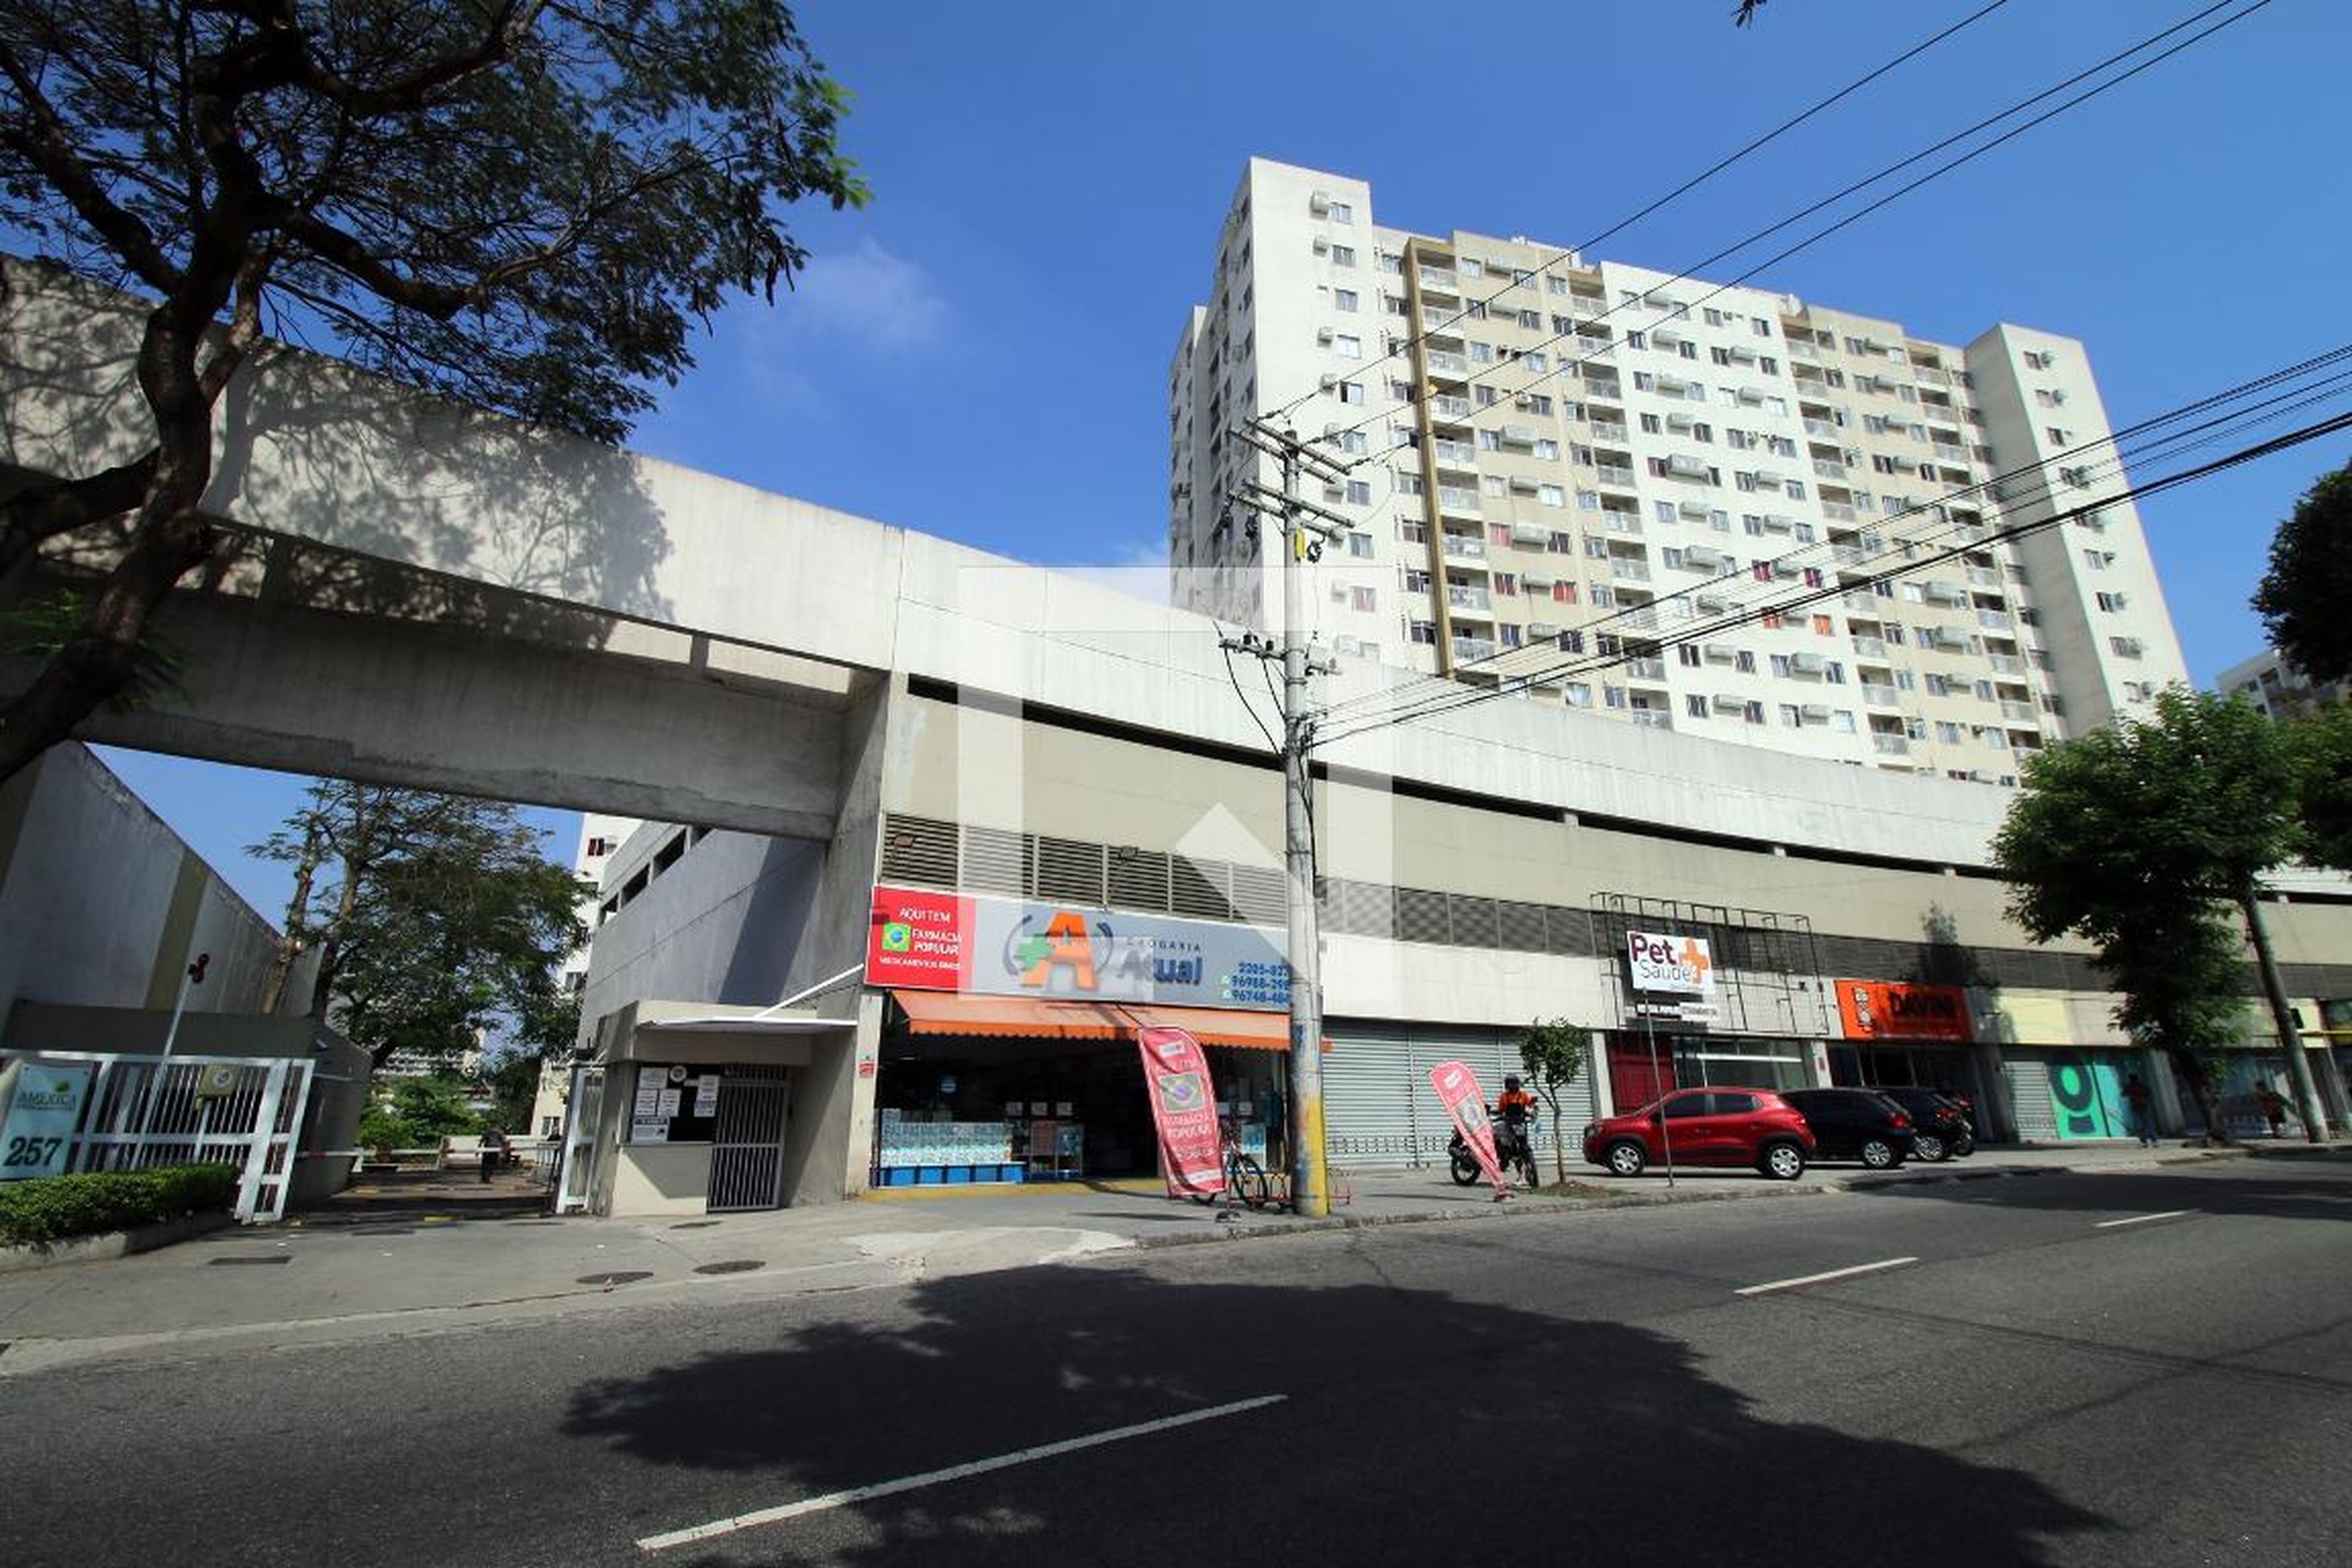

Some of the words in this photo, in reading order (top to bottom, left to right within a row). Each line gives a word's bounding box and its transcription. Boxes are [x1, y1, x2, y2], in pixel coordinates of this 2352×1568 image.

[914, 941, 959, 956] POPULAR
[1630, 933, 1676, 965] Pet
[4, 1137, 63, 1166] 257
